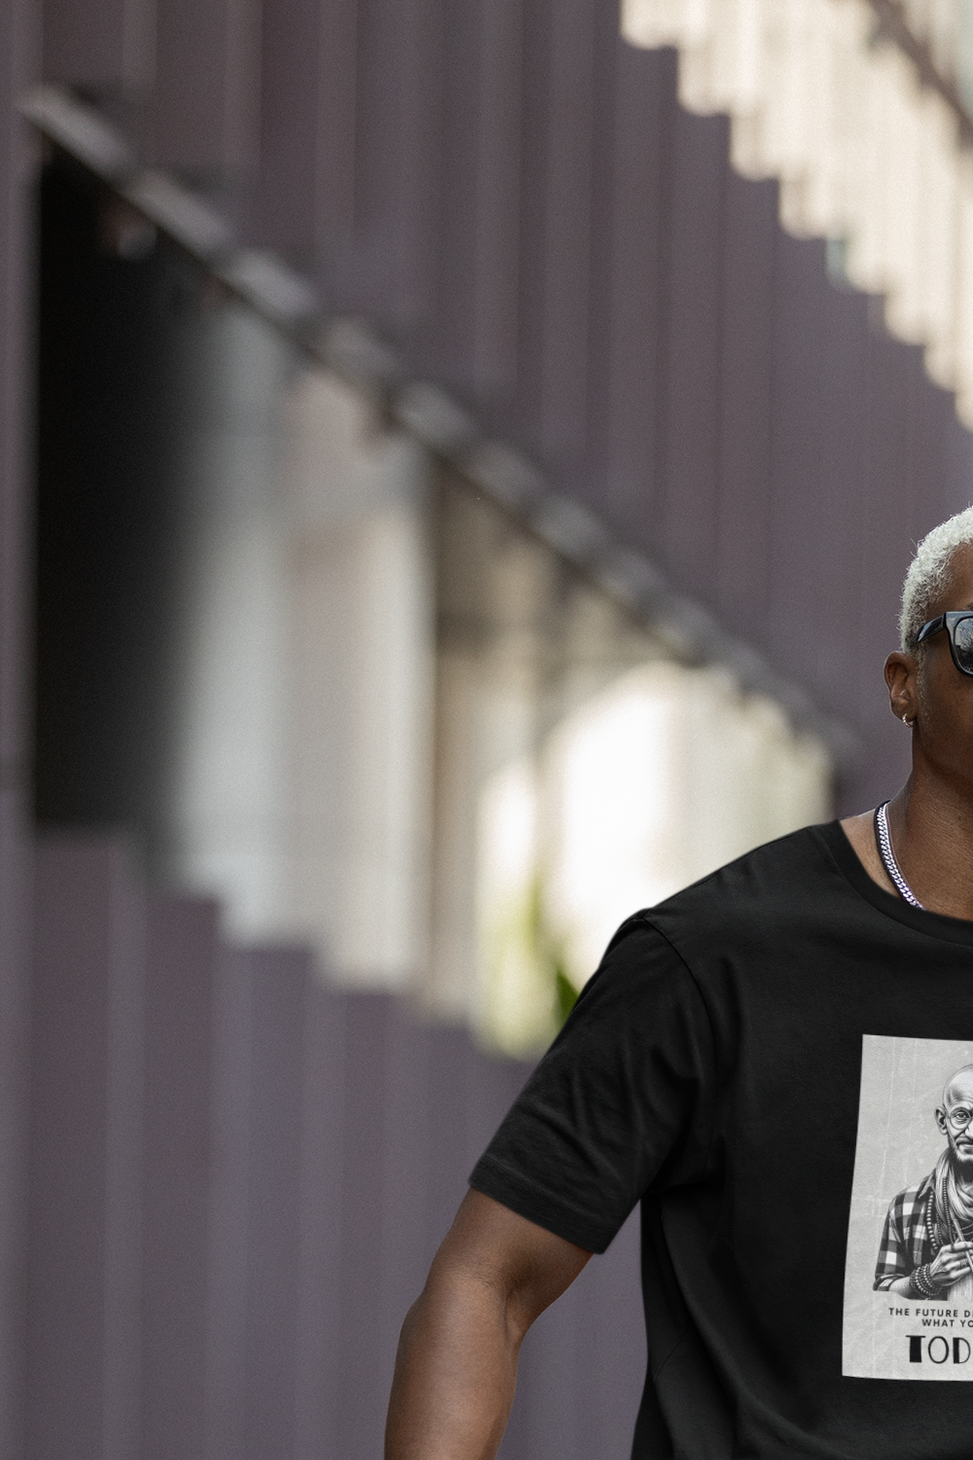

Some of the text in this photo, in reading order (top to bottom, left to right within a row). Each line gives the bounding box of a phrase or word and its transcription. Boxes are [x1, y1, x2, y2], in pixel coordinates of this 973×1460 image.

[888, 1307, 910, 1317] THE
[915, 1308, 959, 1318] FUTURE
[921, 1318, 955, 1328] WHAT
